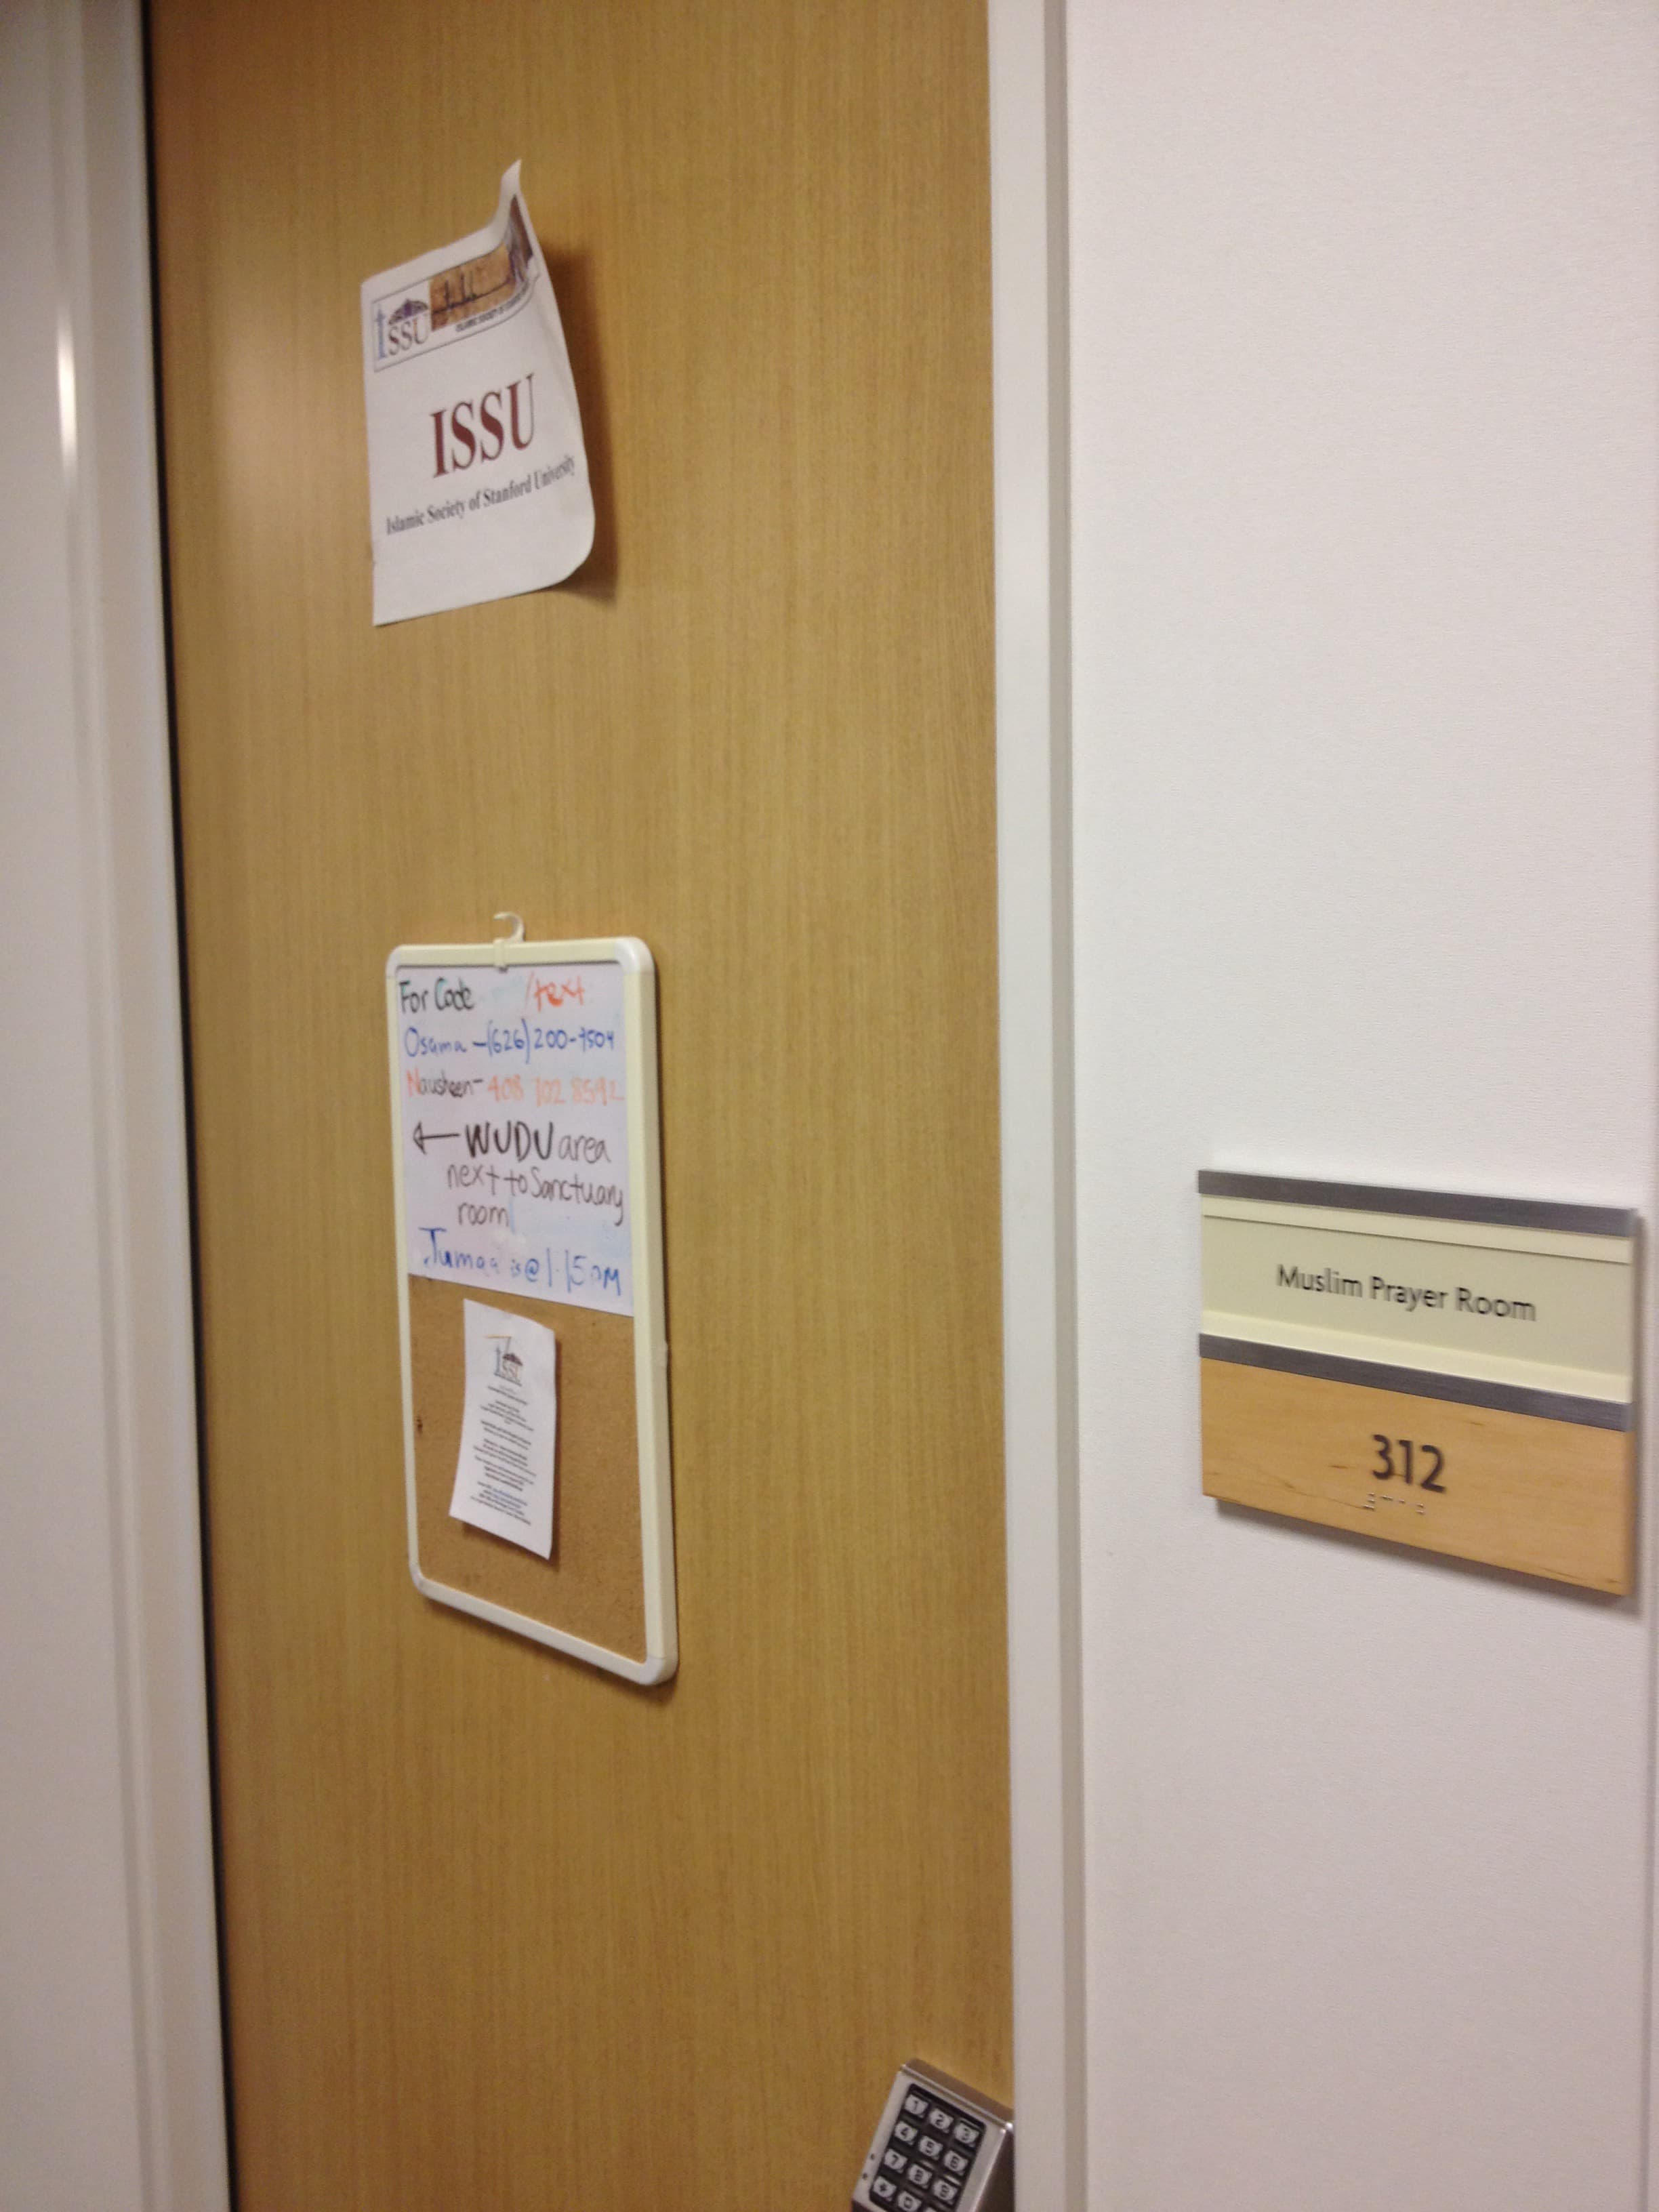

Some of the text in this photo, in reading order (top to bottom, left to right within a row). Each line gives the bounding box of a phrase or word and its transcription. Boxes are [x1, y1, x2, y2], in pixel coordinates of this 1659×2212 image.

[429, 373, 535, 478] ISSU
[386, 455, 575, 535] Islamic Society of Stanford University
[400, 980, 429, 1012] For
[434, 977, 474, 1010] Code
[404, 1027, 467, 1057] Osama
[466, 1120, 612, 1164] WUDU area
[447, 1164, 623, 1227] next to Sanctuary
[457, 1202, 509, 1227] room
[1277, 1264, 1537, 1321] Muslim Prayer Room
[1371, 1434, 1447, 1494] 312
